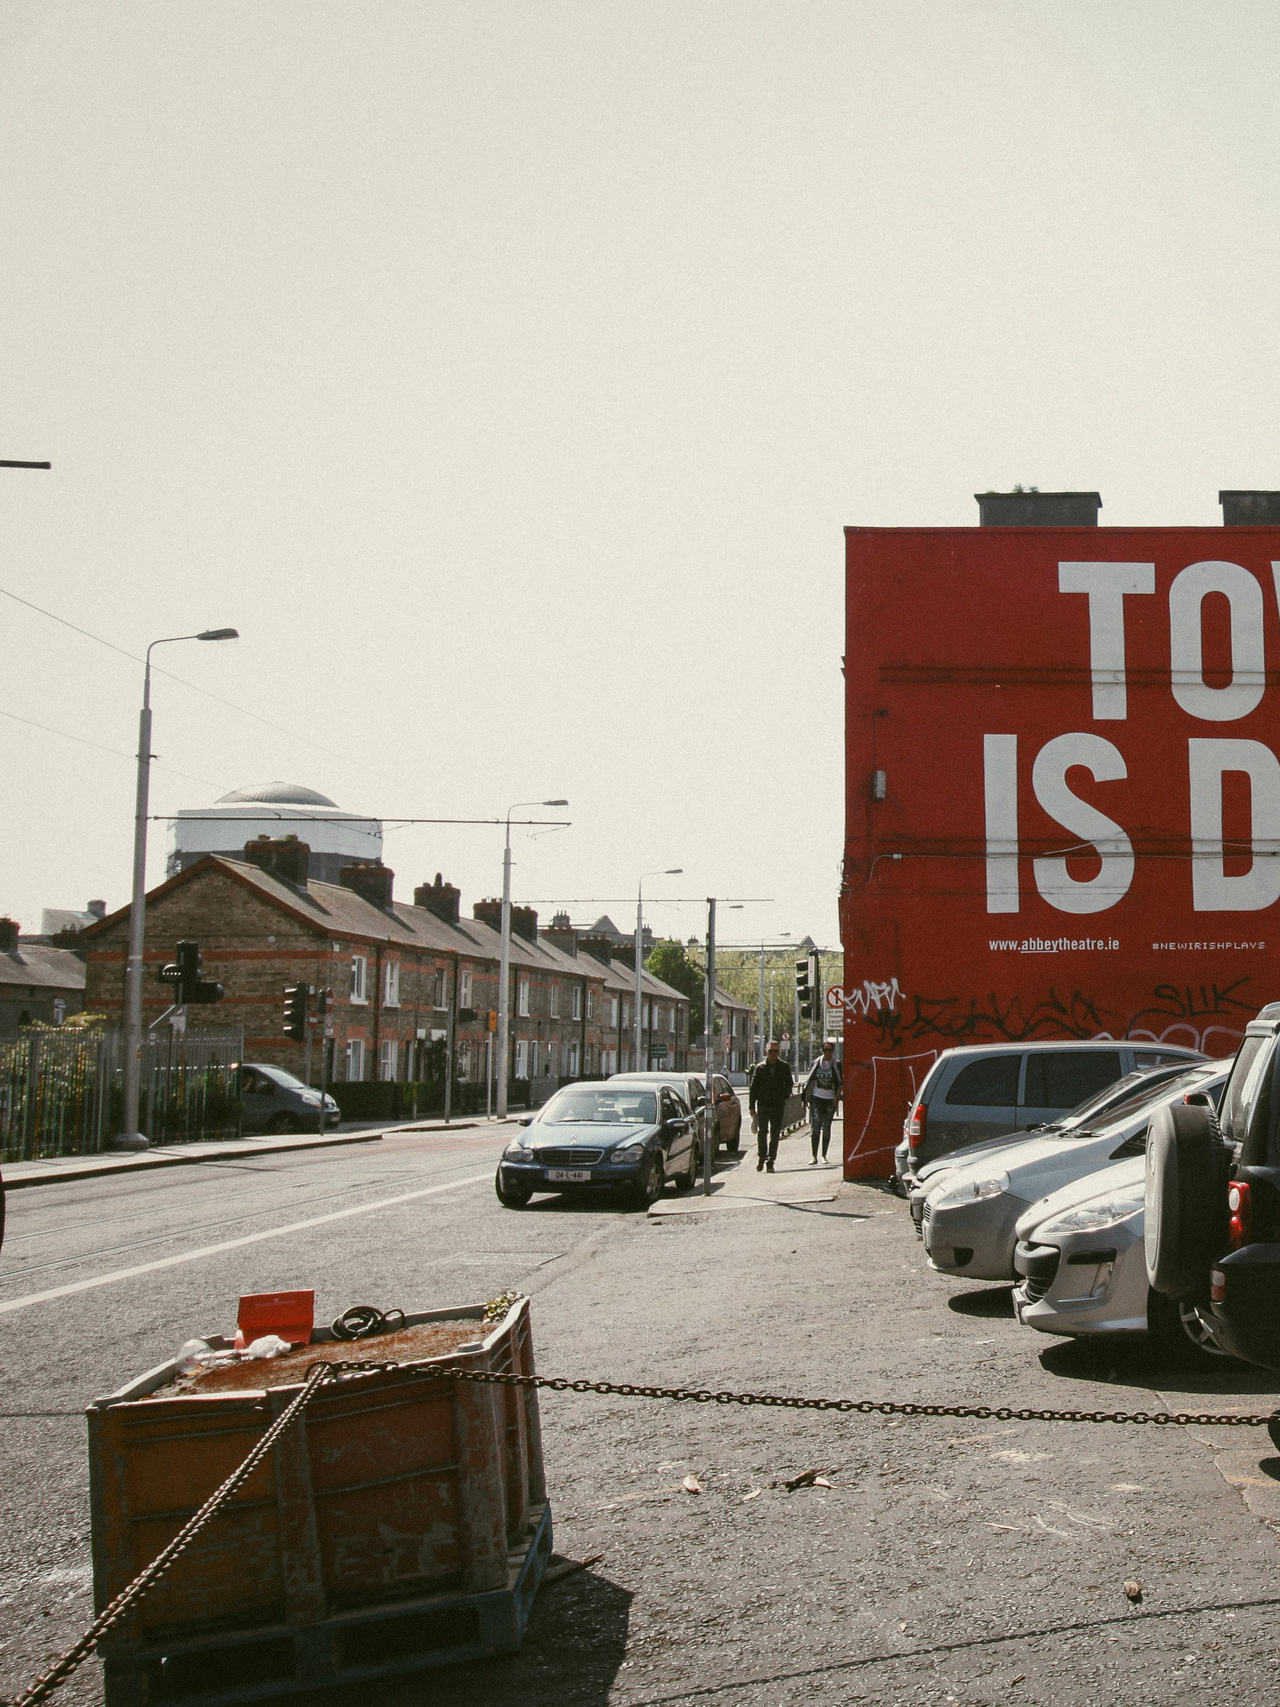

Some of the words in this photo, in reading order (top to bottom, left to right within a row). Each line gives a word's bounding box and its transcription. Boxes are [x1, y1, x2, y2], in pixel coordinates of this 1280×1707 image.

[983, 732, 1133, 915] IS
[988, 937, 1120, 954] www.abbeytheatre.ie
[1151, 941, 1266, 951] #NEWIRISHPLAYS
